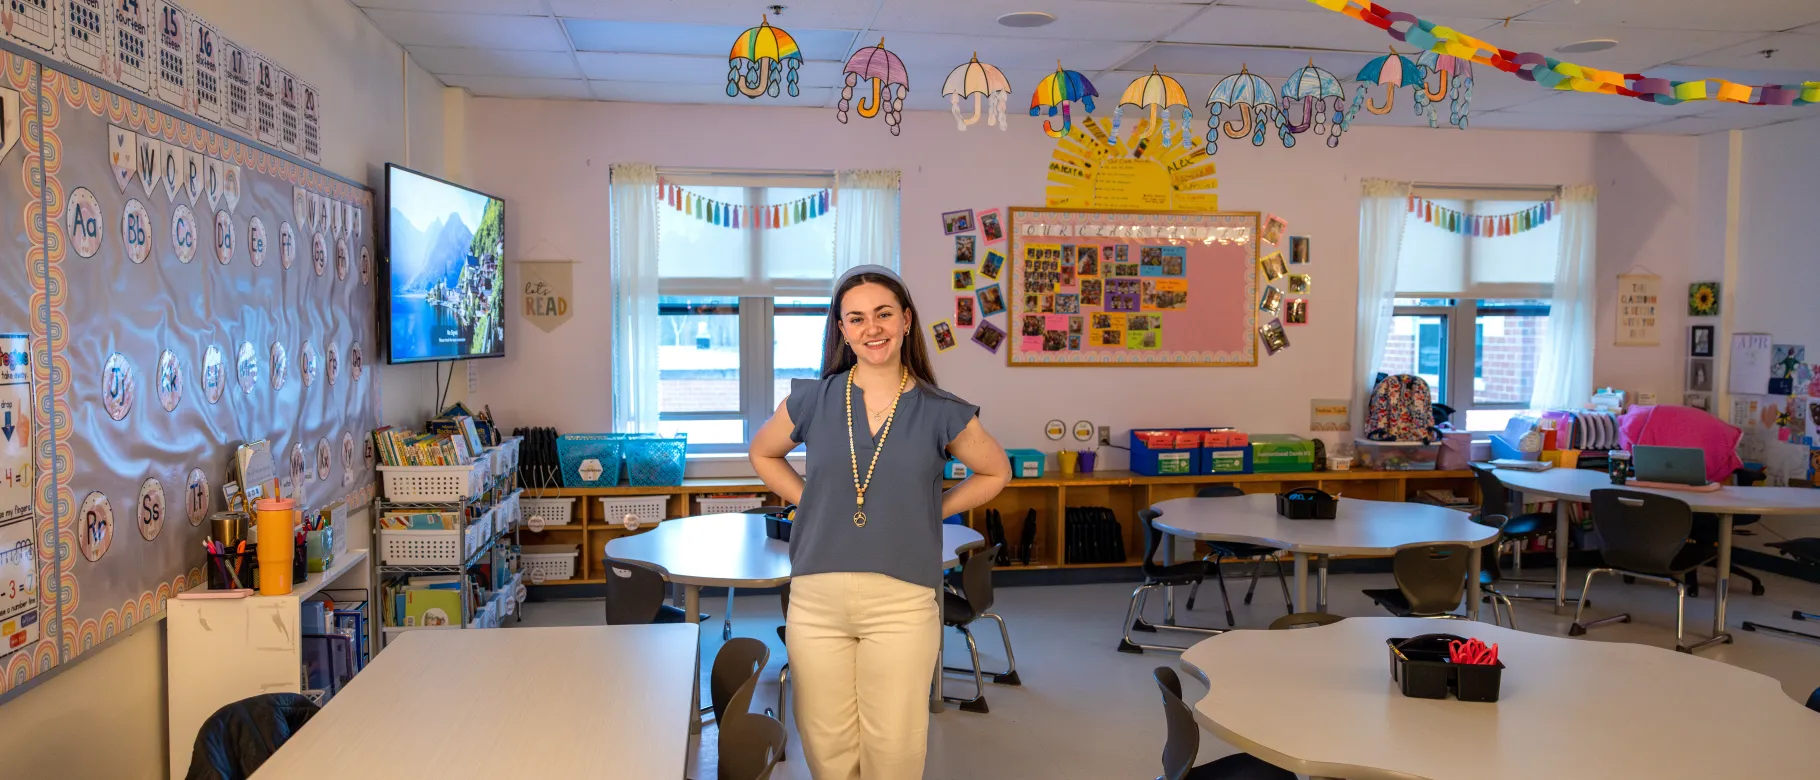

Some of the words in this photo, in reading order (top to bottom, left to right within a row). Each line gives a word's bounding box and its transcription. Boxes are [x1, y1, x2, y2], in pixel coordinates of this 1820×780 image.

[116, 9, 146, 35] fourteen
[163, 6, 178, 37] 15
[160, 33, 182, 52] fifteen
[199, 27, 212, 57] 16
[232, 50, 242, 74] 17
[259, 62, 271, 88] 18
[283, 75, 293, 100] 19
[304, 88, 315, 111] 20
[73, 203, 97, 237] Aa
[127, 213, 145, 246] Bb
[176, 217, 193, 248] Cc
[218, 222, 231, 249] Dd
[252, 227, 263, 252] Ee
[282, 232, 291, 256] Ff
[315, 241, 324, 268] Gg
[525, 296, 568, 317] READ
[1737, 336, 1768, 350] APR
[1, 370, 13, 380] take
[110, 367, 125, 406] Jj
[161, 366, 177, 394] Kk
[1, 400, 12, 409] drop
[320, 449, 329, 468] Xx
[6, 468, 13, 488] 4
[143, 493, 160, 524] Ss
[190, 483, 203, 513] Tt
[5, 510, 13, 518] my
[87, 511, 107, 545] Rr
[9, 580, 16, 599] 3
[27, 573, 33, 591] 7
[11, 601, 28, 613] number
